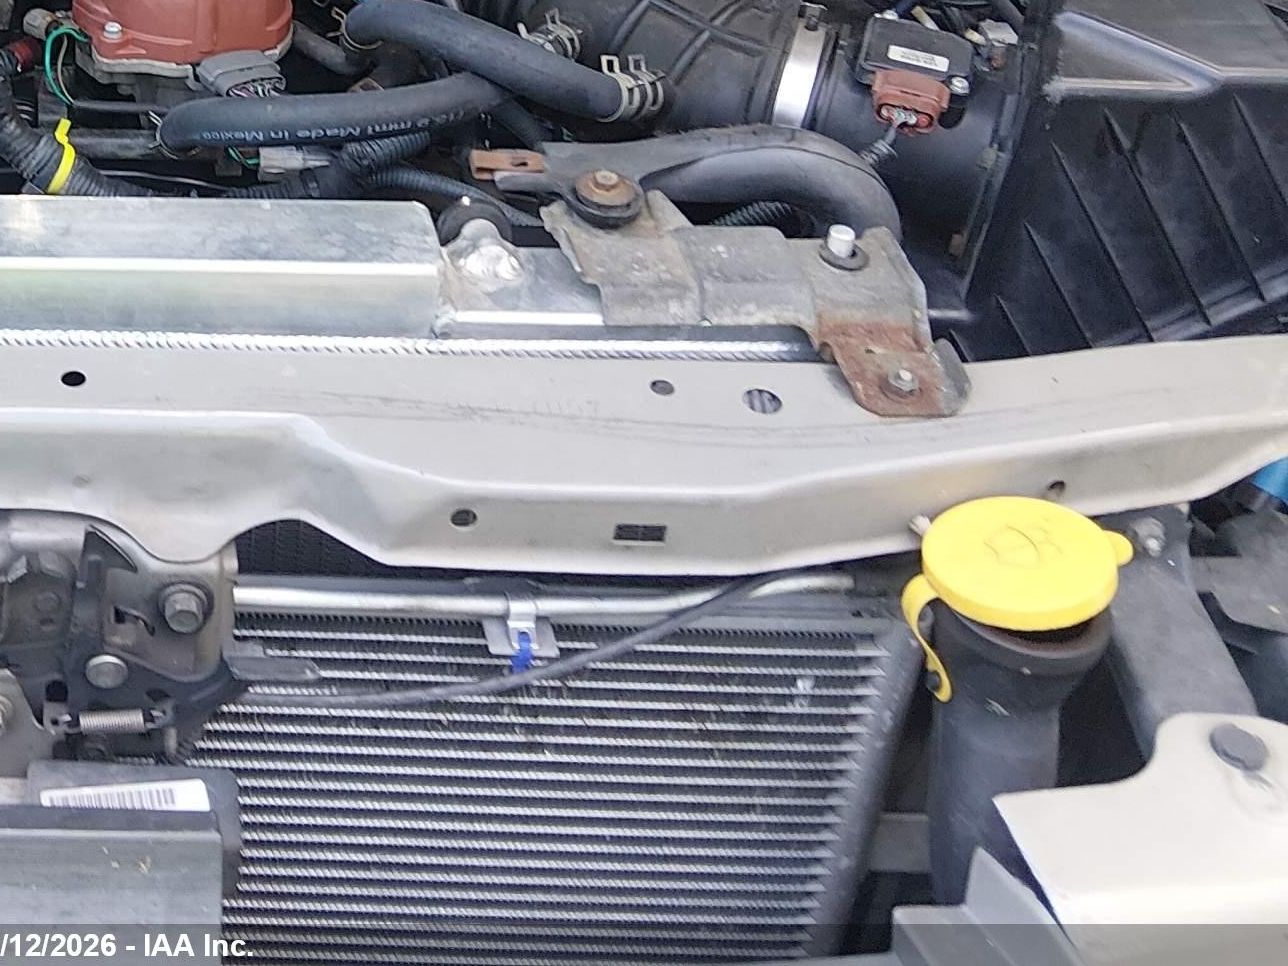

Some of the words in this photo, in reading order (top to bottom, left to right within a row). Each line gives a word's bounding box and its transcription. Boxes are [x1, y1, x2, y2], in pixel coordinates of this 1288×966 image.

[200, 130, 264, 141] Mexico
[270, 129, 289, 140] in
[296, 126, 360, 139] Made
